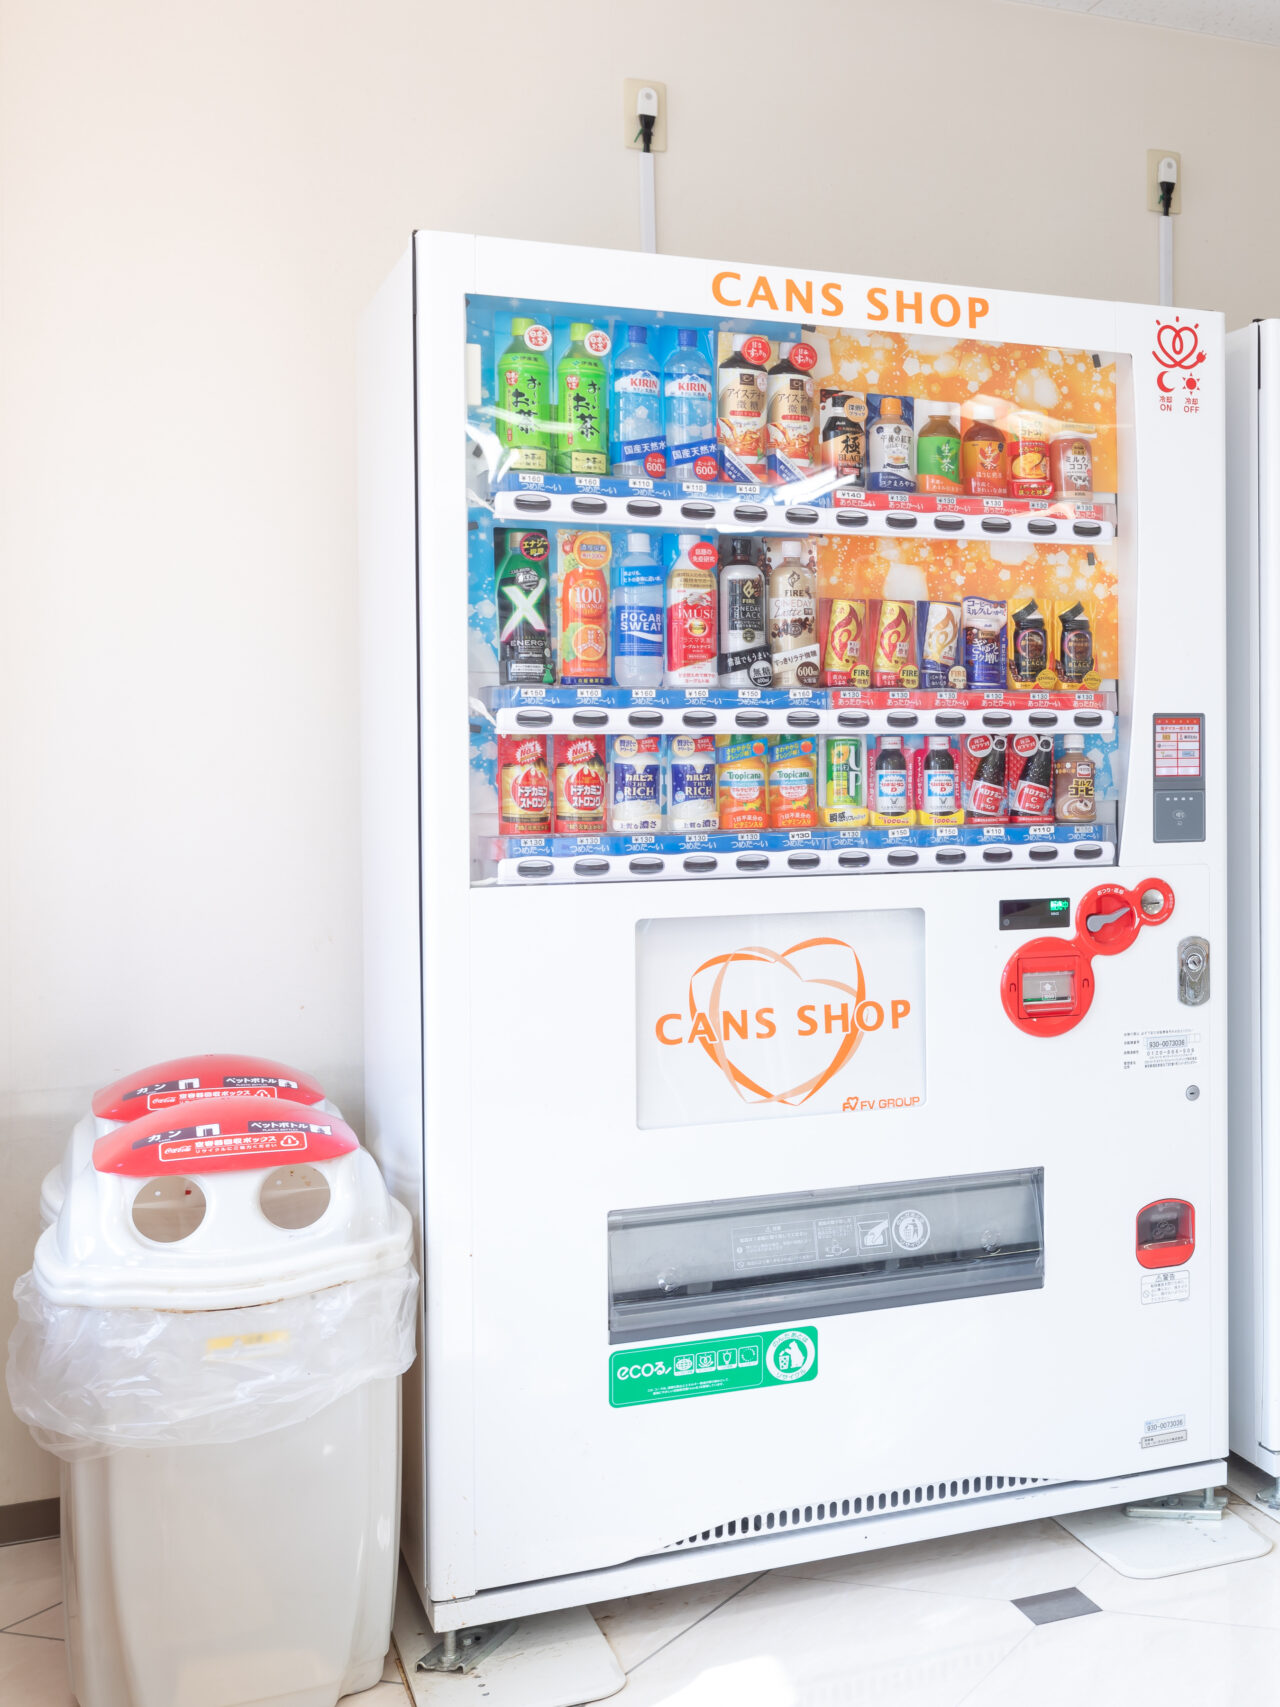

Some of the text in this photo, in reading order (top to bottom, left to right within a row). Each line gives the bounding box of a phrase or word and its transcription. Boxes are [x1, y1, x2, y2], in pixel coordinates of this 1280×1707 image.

[711, 271, 990, 329] CANS SHOP
[630, 378, 658, 389] KIRIN
[678, 381, 707, 392] KIRIN
[1183, 405, 1200, 413] OFF
[624, 439, 666, 455] 国産天然水
[841, 435, 860, 454] 極
[672, 443, 717, 460] 国産天然水
[984, 445, 997, 469] 生茶
[941, 443, 955, 472] 生茶
[521, 475, 542, 483] ¥160
[578, 479, 597, 487] ¥160
[632, 480, 651, 488] ¥110
[575, 586, 602, 604] 100
[784, 589, 804, 597] FIRE
[621, 621, 662, 631] SWEAT
[853, 669, 870, 677] FIRE
[902, 669, 918, 677] FIRE
[686, 773, 711, 781] カルピス
[727, 770, 762, 780] Tropicana
[777, 770, 810, 780] Tropicana
[1073, 779, 1093, 787] ミルク
[518, 786, 548, 797] ドデカミン
[571, 785, 602, 796] ドデカミン
[624, 786, 654, 796] RICH
[685, 786, 712, 796] RICH
[521, 797, 547, 808] ストロング
[572, 797, 601, 808] ストロング
[655, 999, 911, 1046] CANS SHOP
[136, 1083, 165, 1095] カン
[860, 1096, 920, 1110] FV GROUP
[251, 1121, 308, 1129] ペットボトル
[147, 1130, 182, 1143] カン
